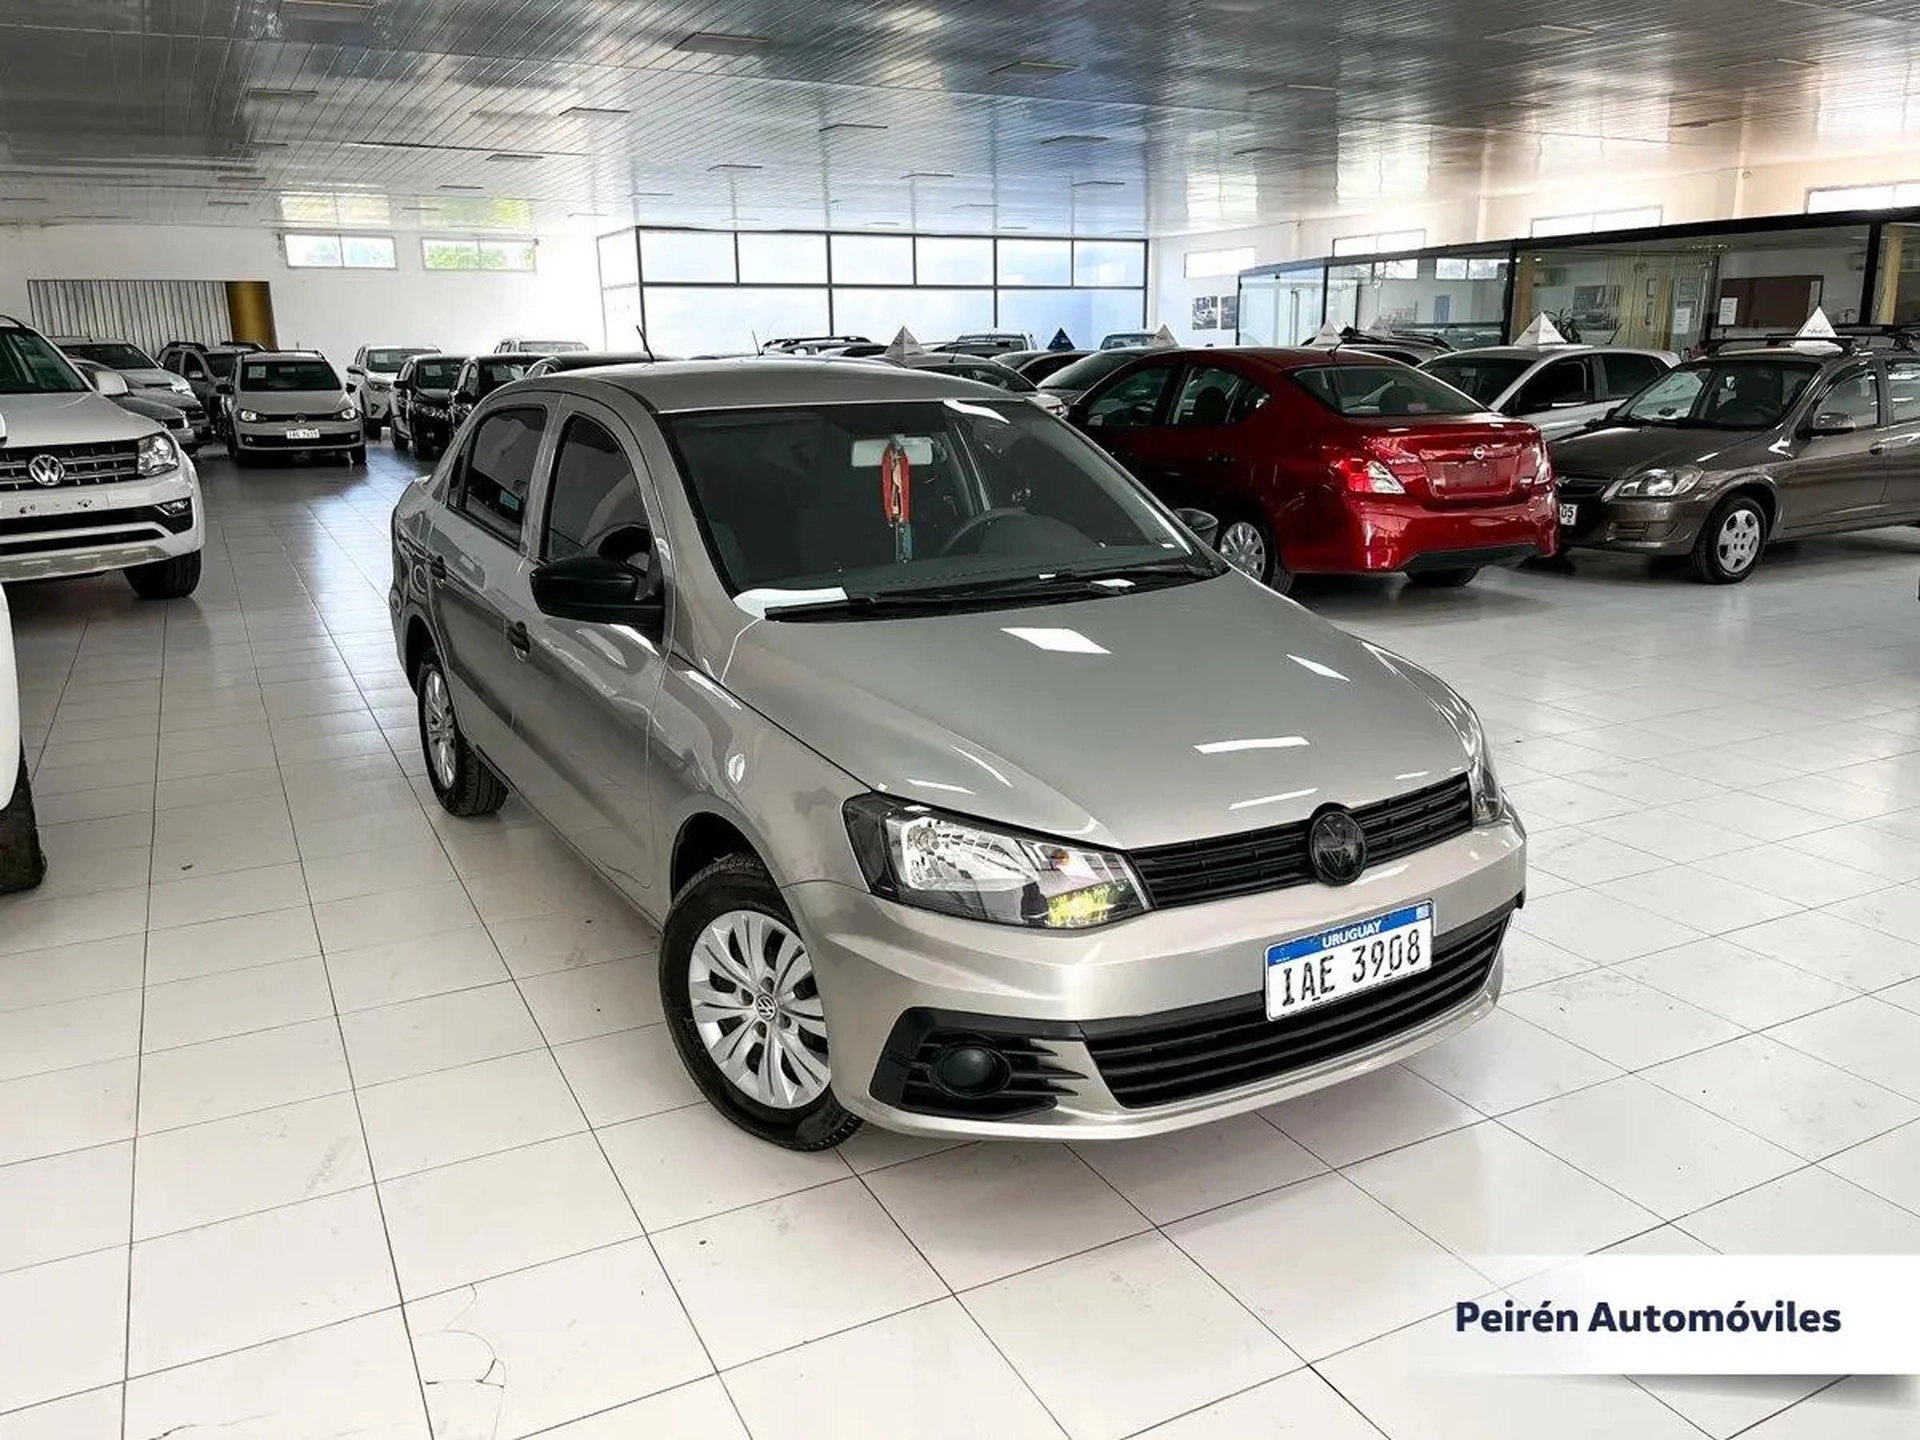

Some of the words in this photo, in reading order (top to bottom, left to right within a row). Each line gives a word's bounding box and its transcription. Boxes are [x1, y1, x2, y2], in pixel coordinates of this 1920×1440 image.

[1321, 920, 1382, 949] URUGUAY
[1281, 954, 1336, 1007] IAE
[1351, 928, 1421, 983] 3908
